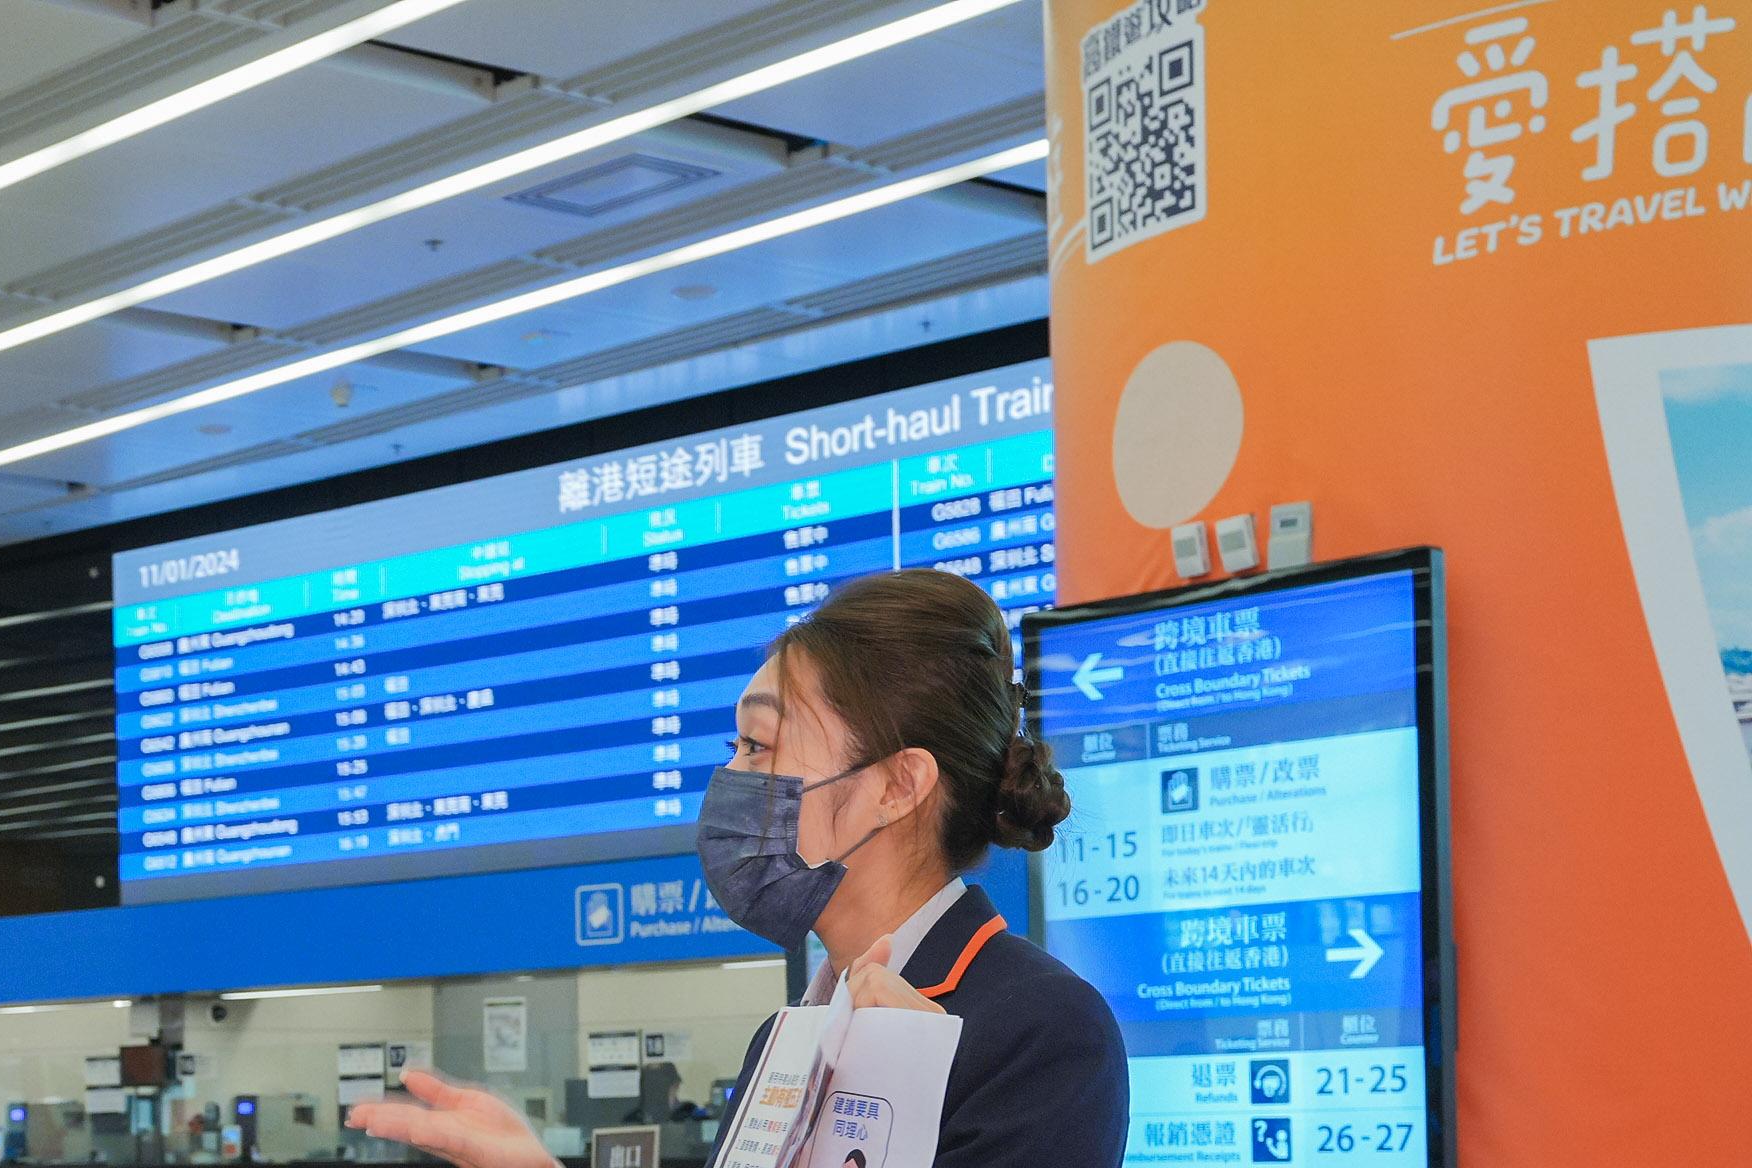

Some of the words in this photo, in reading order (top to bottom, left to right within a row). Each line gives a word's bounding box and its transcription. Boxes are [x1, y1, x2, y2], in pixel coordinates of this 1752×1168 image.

[1431, 5, 1752, 216] 愛搭
[1433, 213, 1543, 266] LET'S
[1554, 186, 1706, 238] TRAVEL
[1717, 179, 1752, 213] W
[558, 433, 766, 514] 離港短途列車
[785, 394, 961, 465] Short-haul
[139, 548, 240, 588] 11/01/2024
[1155, 607, 1260, 650] 跨境車票
[1194, 672, 1261, 693] Boundary
[1262, 664, 1311, 683] Tickets
[1210, 754, 1319, 791] 購票/改票
[1267, 786, 1326, 801] Alterations
[1180, 911, 1287, 948] 跨境車票
[1137, 982, 1173, 999] Cross
[1175, 979, 1241, 998] Boundary
[1242, 976, 1291, 992] Tickets
[1196, 1152, 1240, 1164] Receipts
